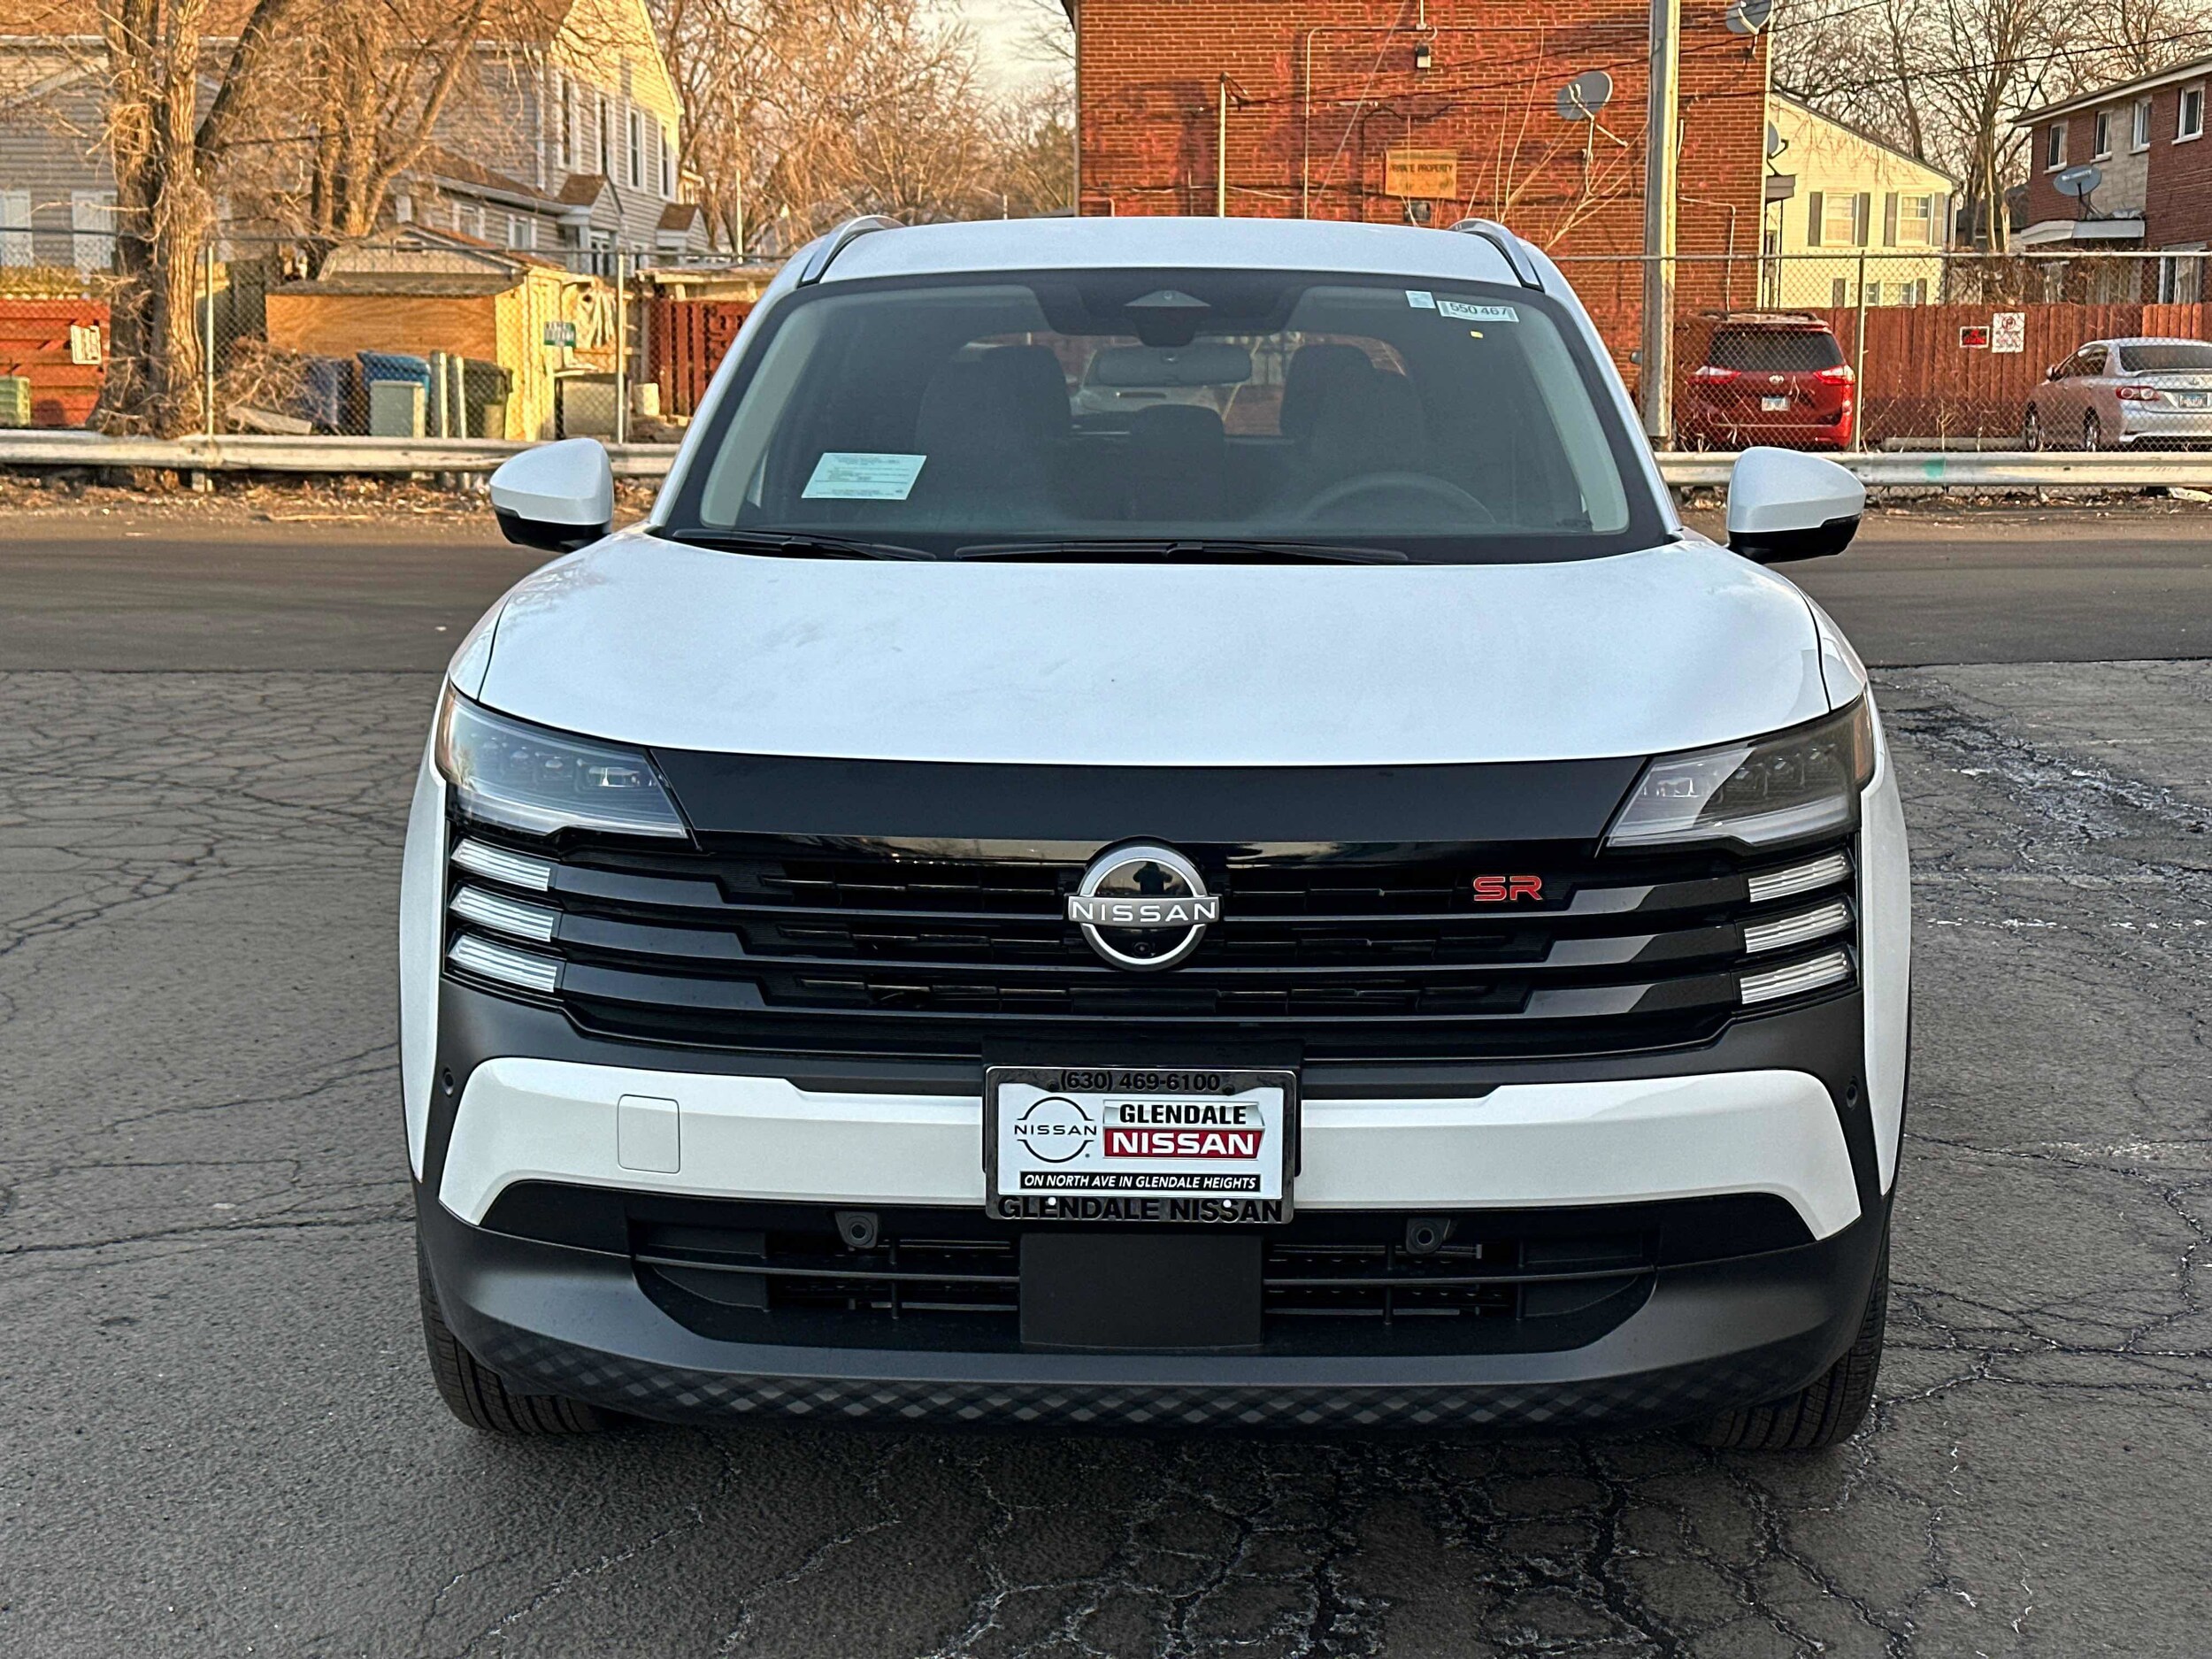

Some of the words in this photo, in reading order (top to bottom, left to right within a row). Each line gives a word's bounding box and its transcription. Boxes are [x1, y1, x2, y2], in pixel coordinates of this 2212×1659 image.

[1417, 164, 1453, 173] PROPERTY
[1449, 303, 1478, 314] 550
[1480, 306, 1508, 316] 467
[1473, 875, 1543, 901] SR
[1071, 901, 1216, 922] NISSAN
[1061, 1070, 1113, 1091] (630)
[1119, 1072, 1220, 1091] 469-6100
[1119, 1104, 1246, 1125] GLENDALE
[1014, 1125, 1097, 1135] NISSAN
[1112, 1132, 1254, 1155] NISSAN
[1025, 1174, 1045, 1187] ON
[1046, 1175, 1089, 1187] NORTH
[1091, 1176, 1117, 1187] AVE
[1118, 1176, 1133, 1187] IN
[1135, 1176, 1201, 1188] GLENDALE
[1202, 1177, 1256, 1189] HEIGHTS
[998, 1195, 1160, 1220] GLENDALE
[1170, 1199, 1283, 1223] NISSAN
